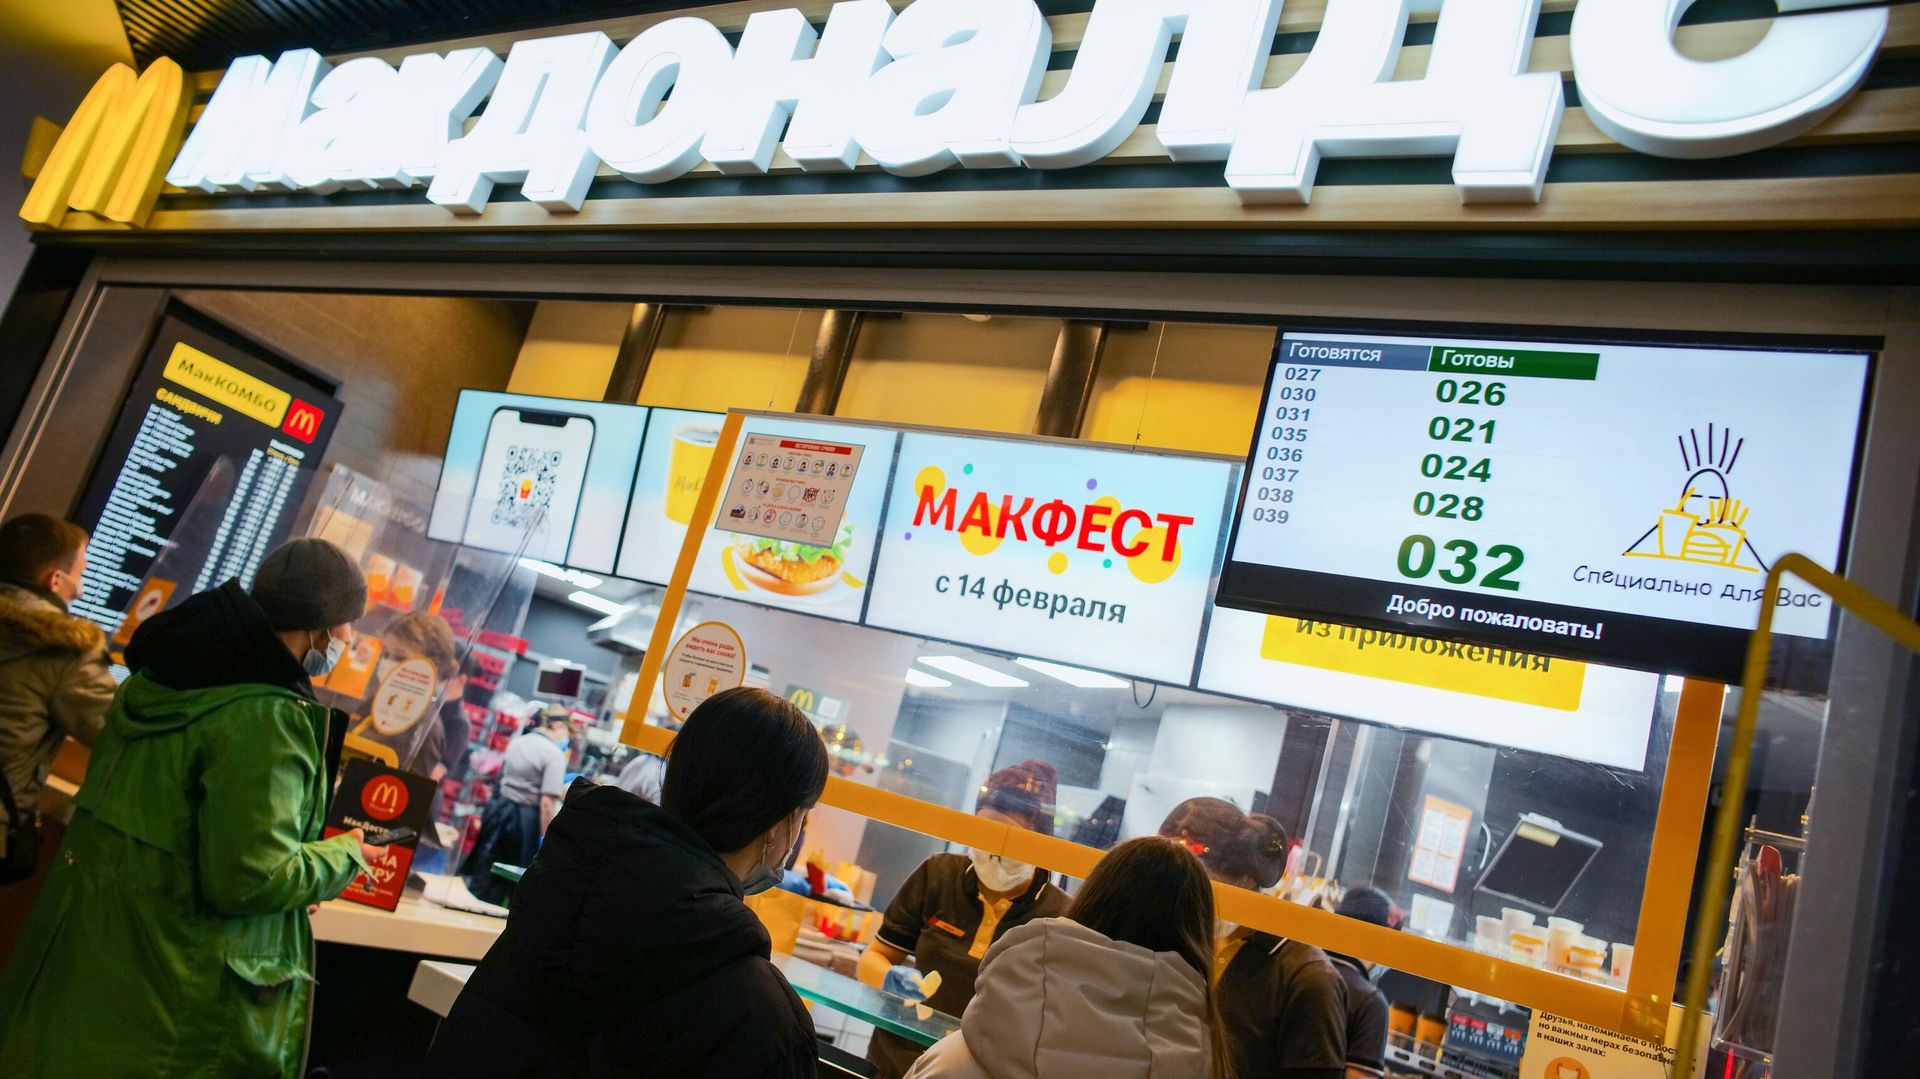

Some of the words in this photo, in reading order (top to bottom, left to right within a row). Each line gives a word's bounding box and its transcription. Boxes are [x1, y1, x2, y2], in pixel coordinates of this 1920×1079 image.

[1288, 343, 1383, 363] Готовятся
[1441, 350, 1515, 369] Готовы
[177, 359, 277, 413] МакКОМБО
[1284, 367, 1322, 382] 027
[1280, 387, 1316, 402] 030
[1435, 379, 1507, 407] 026
[1275, 406, 1311, 422] 031
[1271, 426, 1308, 442] 035
[1428, 416, 1497, 444] 021
[1266, 446, 1304, 463] 036
[1420, 453, 1492, 483] 024
[1261, 466, 1300, 483] 037
[1257, 487, 1294, 504] 038
[1412, 491, 1484, 522] 028
[912, 484, 1195, 562] МАКФЕСТ
[1252, 507, 1290, 525] 039
[1396, 534, 1525, 592] 032
[935, 574, 950, 593] с
[958, 574, 986, 600] 14
[993, 578, 1127, 624] февраля
[1572, 565, 1713, 597] Специально
[1775, 587, 1822, 608] Вас
[1386, 594, 1456, 621] Добро
[1460, 605, 1604, 640] пожаловать!
[1295, 618, 1332, 638] из
[1338, 625, 1551, 673] приложения
[1538, 1022, 1550, 1031] но
[1551, 1025, 1588, 1042] важных
[1590, 1036, 1620, 1051] мерах
[1540, 1011, 1576, 1028] Друзья,
[1577, 1021, 1639, 1045] напоминаем
[1536, 1031, 1543, 1039] в
[1543, 1034, 1574, 1049] наших
[1575, 1043, 1606, 1058] залах:
